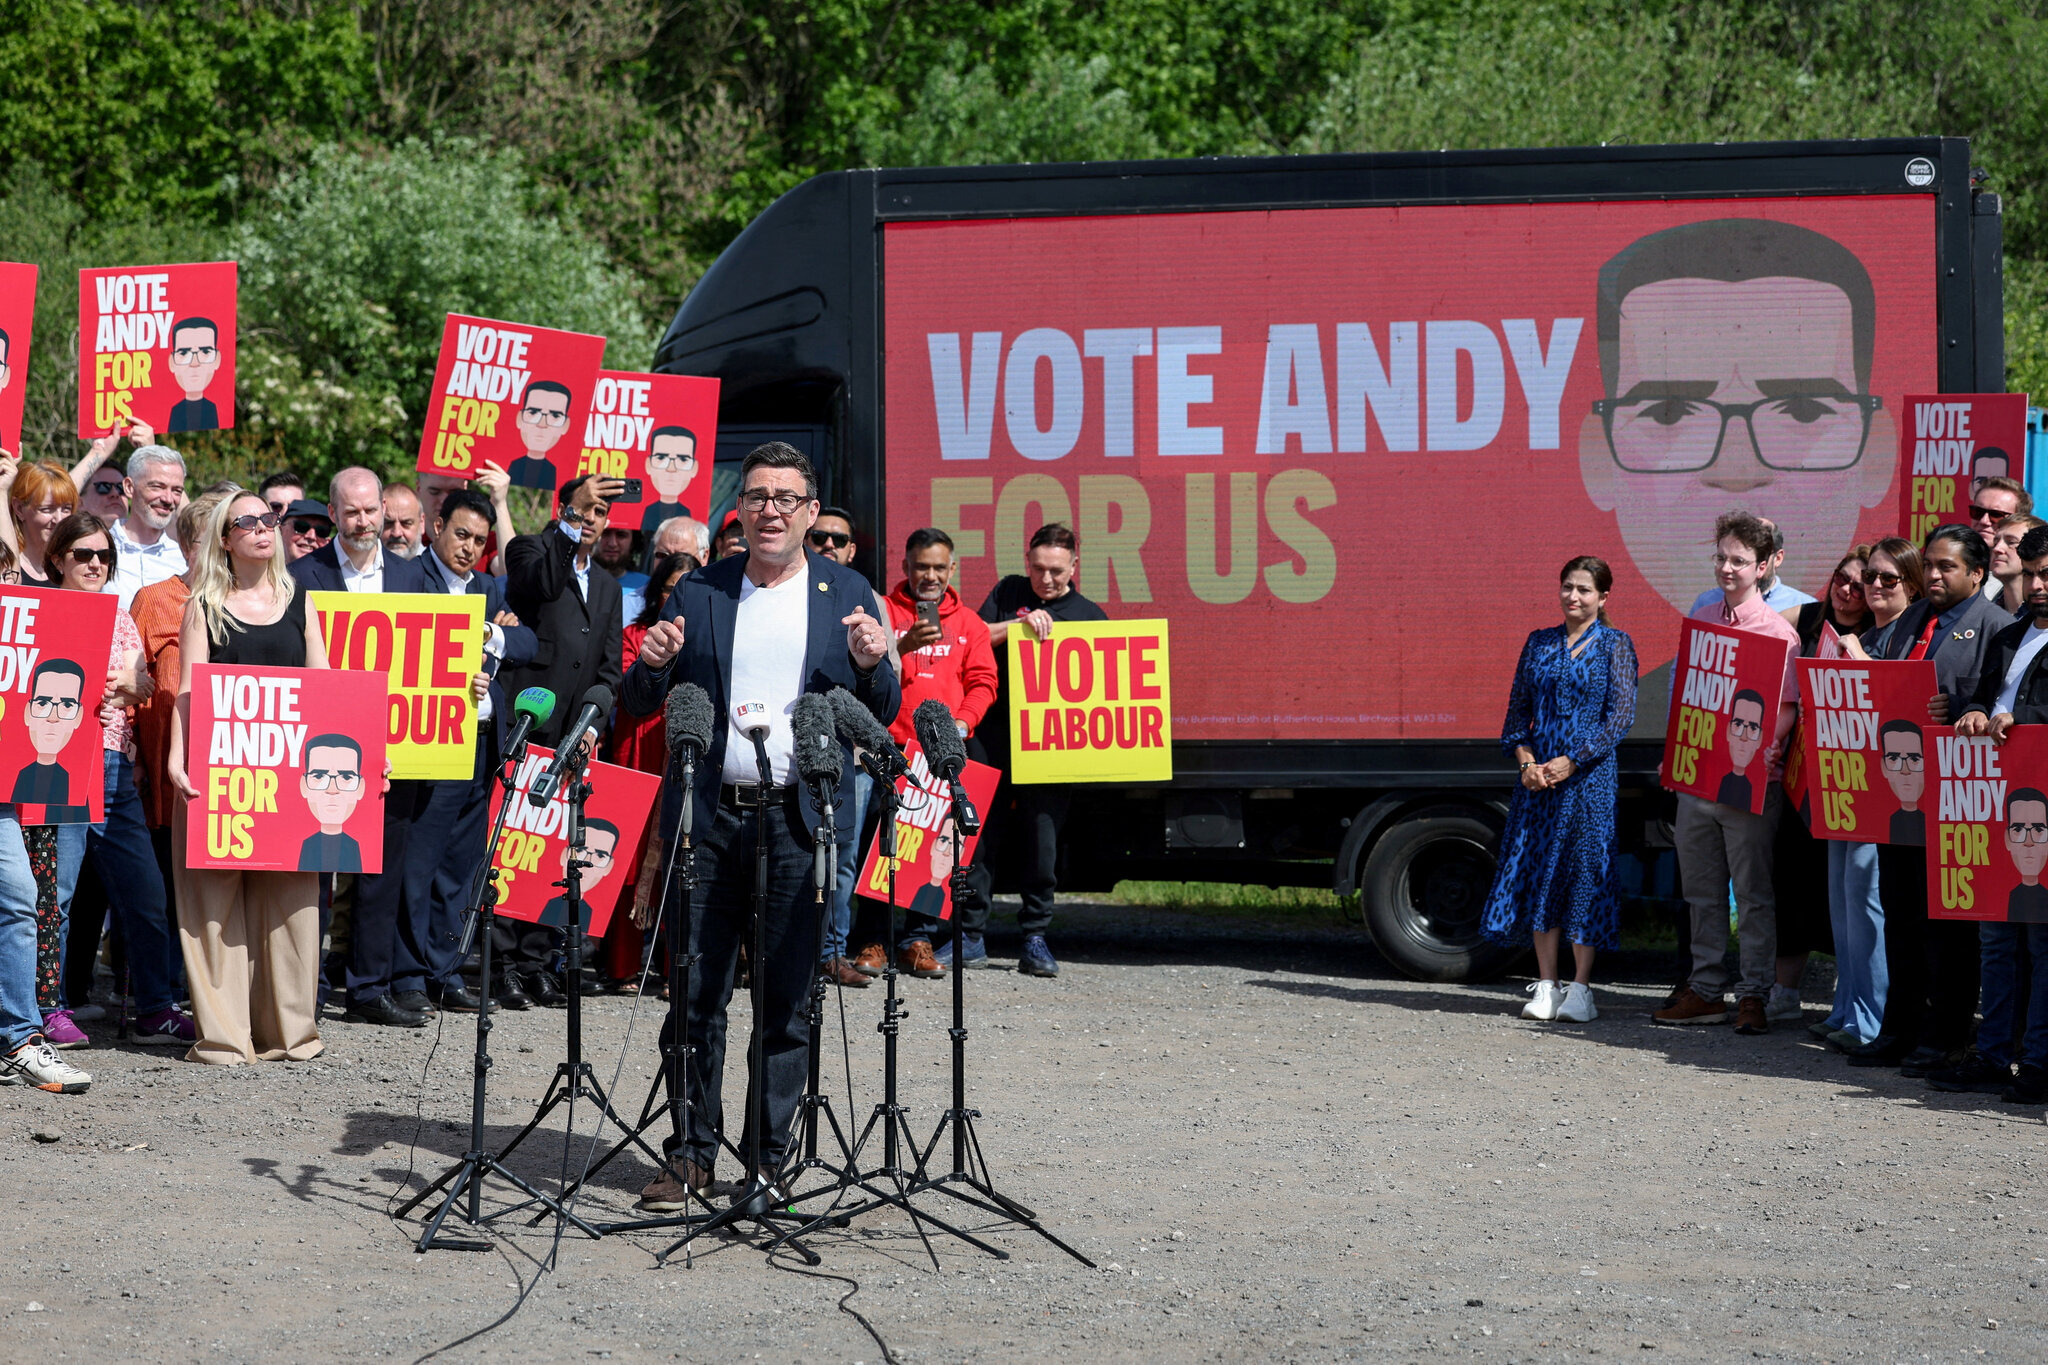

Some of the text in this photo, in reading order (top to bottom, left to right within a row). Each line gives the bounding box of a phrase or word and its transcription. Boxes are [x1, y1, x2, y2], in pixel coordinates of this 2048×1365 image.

[95, 273, 169, 314] VOTE
[95, 311, 174, 352] ANDY
[456, 324, 533, 369] VOTE
[95, 352, 152, 391] FOR
[446, 360, 532, 404] ANDY
[927, 317, 1584, 460] VOTE ANDY
[95, 390, 134, 429] US
[439, 395, 500, 437] FOR
[590, 377, 651, 416] OTE
[1914, 402, 1972, 439] VOTE
[433, 432, 475, 470] US
[1912, 440, 1975, 476] ANDY
[1911, 477, 1956, 513] FOR
[930, 469, 1337, 605] FOR US
[0, 595, 40, 645] TE
[317, 610, 470, 688] VOTE
[1018, 636, 1161, 703] VOTE
[1688, 629, 1740, 676] VOTE
[0, 648, 40, 695] DY
[1681, 667, 1738, 715] ANDY
[1808, 668, 1873, 709] VOTE
[211, 674, 301, 722] VOTE
[386, 693, 466, 745] OUR
[737, 702, 764, 716] LBC
[208, 721, 308, 768] ANDY
[1020, 706, 1164, 751] LABOUR
[1676, 705, 1716, 750] FOR
[1815, 709, 1879, 751] ANDY
[1672, 744, 1699, 786] US
[1818, 750, 1869, 791] FOR
[1936, 735, 2002, 778] VOTE
[208, 767, 278, 813] FOR
[895, 785, 951, 832] ANDY
[1821, 791, 1856, 832] US
[1938, 779, 2007, 822] ANDY
[207, 813, 255, 859] US
[487, 826, 546, 873] FOR
[895, 822, 924, 863] OR
[1939, 823, 1990, 866] FOR
[1940, 867, 1975, 910] US
